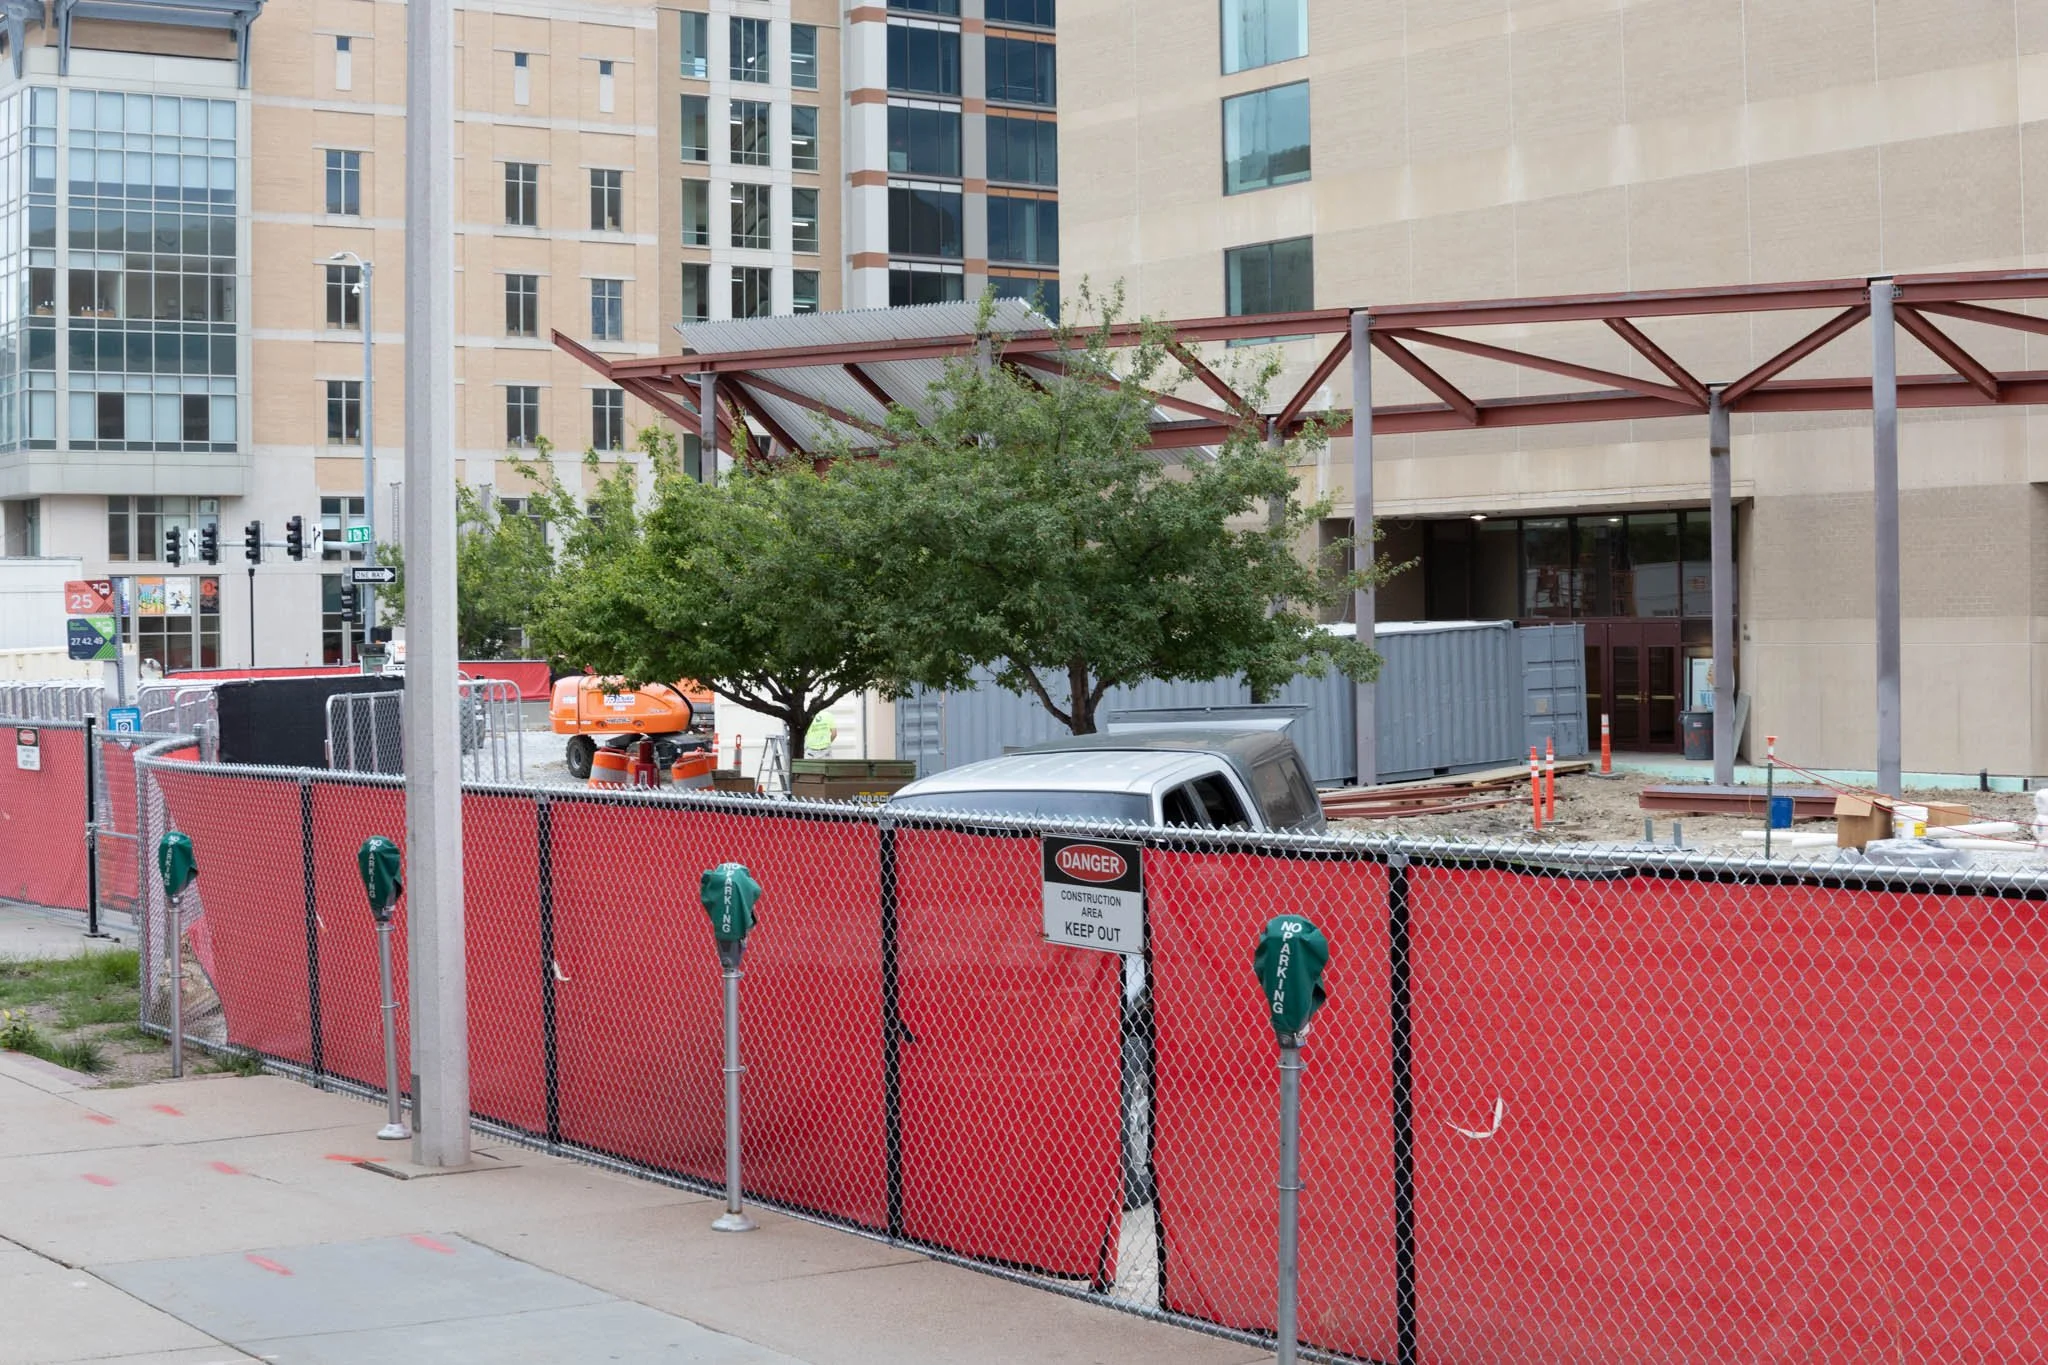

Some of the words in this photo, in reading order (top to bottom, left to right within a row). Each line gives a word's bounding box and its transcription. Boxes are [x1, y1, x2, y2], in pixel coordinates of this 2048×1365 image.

[71, 593, 94, 609] 25
[368, 845, 377, 898] PARKING
[1062, 851, 1120, 874] DANGER
[722, 870, 735, 933] PARKING
[1061, 890, 1121, 907] CONSTRUCTION
[1081, 907, 1103, 919] AREA
[1065, 921, 1094, 939] KEEP
[1098, 926, 1121, 943] OUT
[1281, 921, 1302, 933] NO
[1272, 932, 1292, 1015] PARKING
